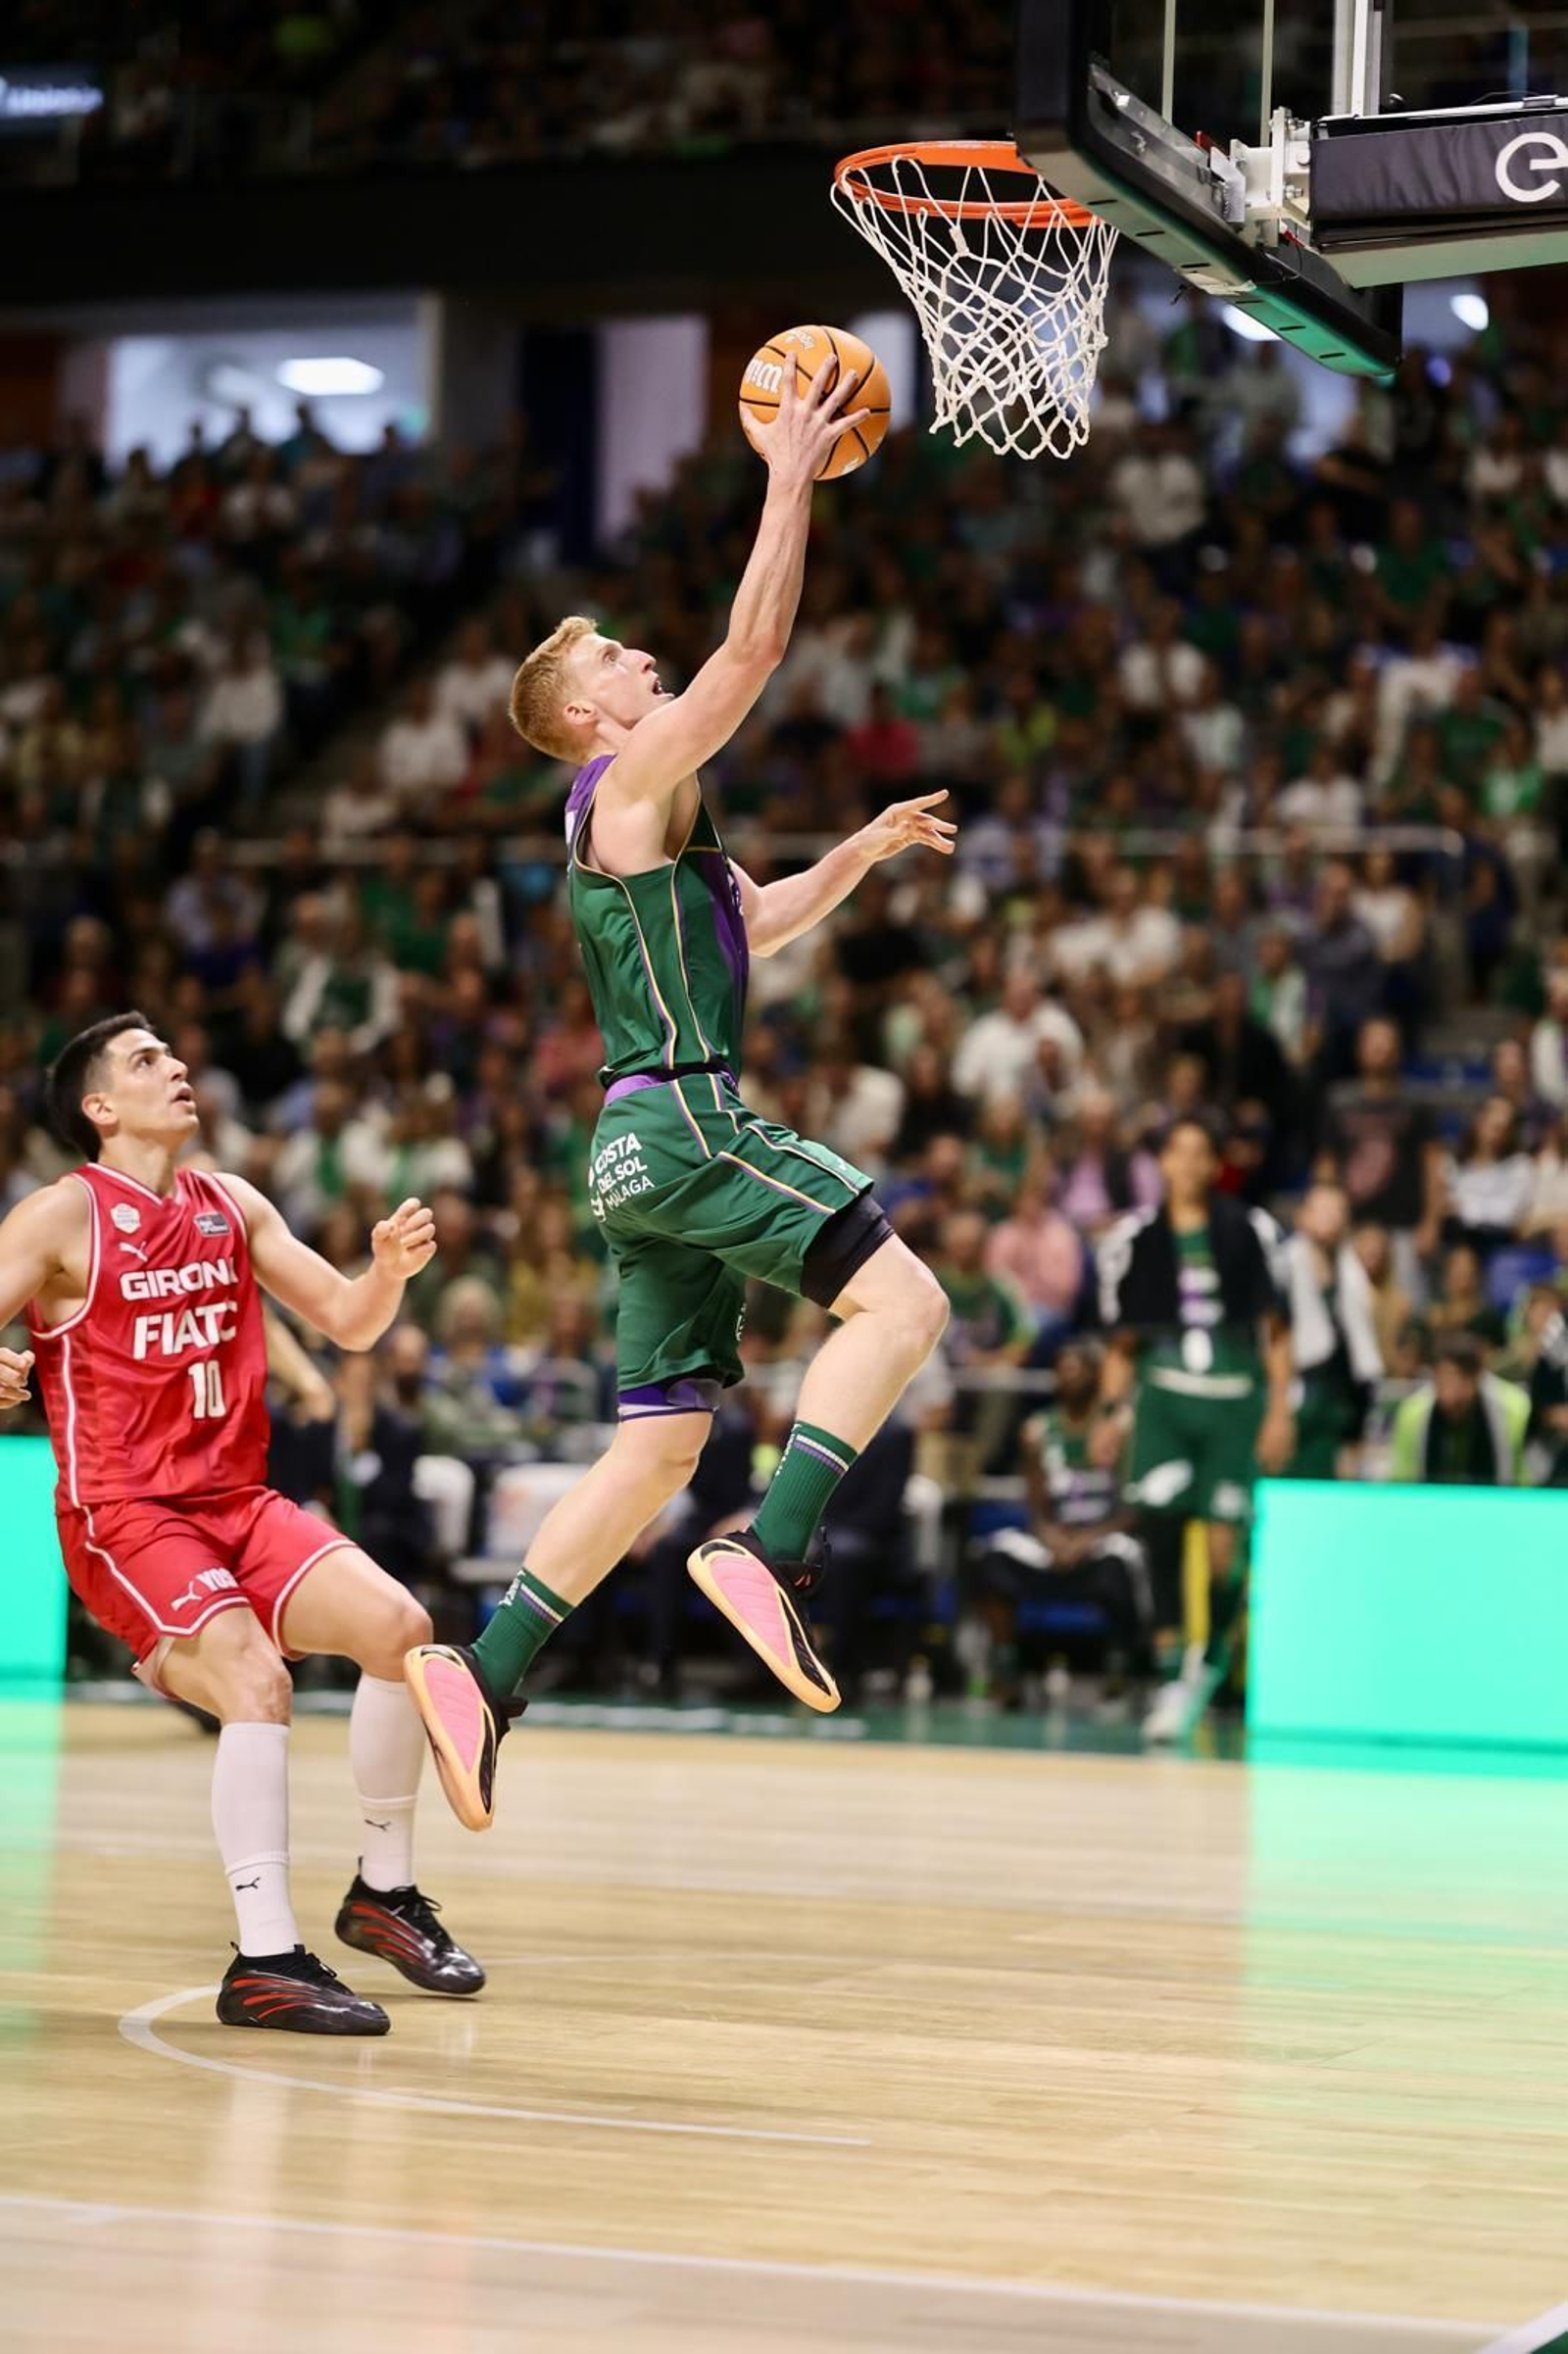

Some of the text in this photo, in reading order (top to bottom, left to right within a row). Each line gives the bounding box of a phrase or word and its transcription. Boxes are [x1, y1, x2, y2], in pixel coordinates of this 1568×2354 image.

[597, 1156, 648, 1195] DEL SOL
[187, 1359, 226, 1419] 10
